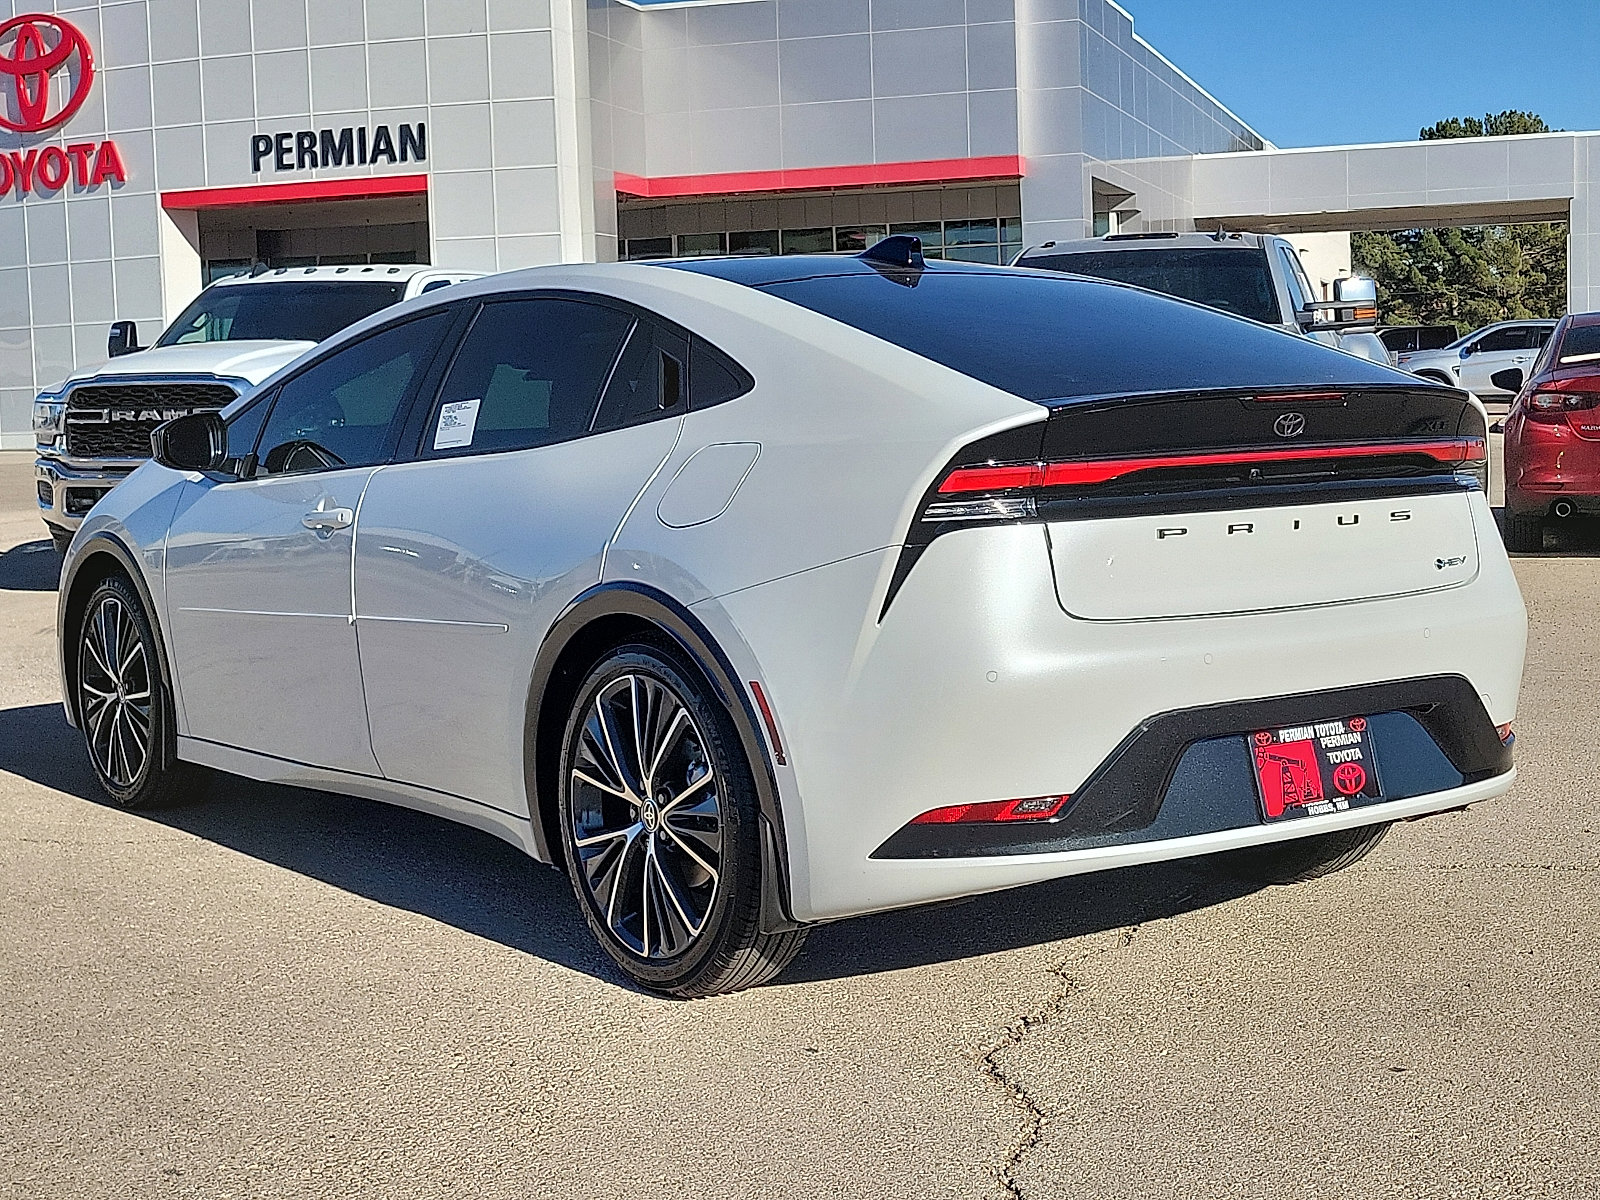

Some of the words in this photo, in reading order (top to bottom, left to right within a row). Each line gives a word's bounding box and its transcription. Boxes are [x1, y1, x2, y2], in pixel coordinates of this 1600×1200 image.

[251, 122, 427, 174] PERMIAN
[112, 409, 188, 421] RAM
[1156, 510, 1411, 539] PRIUS
[1443, 555, 1467, 567] HEV
[1279, 725, 1315, 743] PERMIAN
[1314, 721, 1345, 738] TOYOTA
[1320, 732, 1362, 748] PERMIAN
[1327, 748, 1363, 764] TOYOTA
